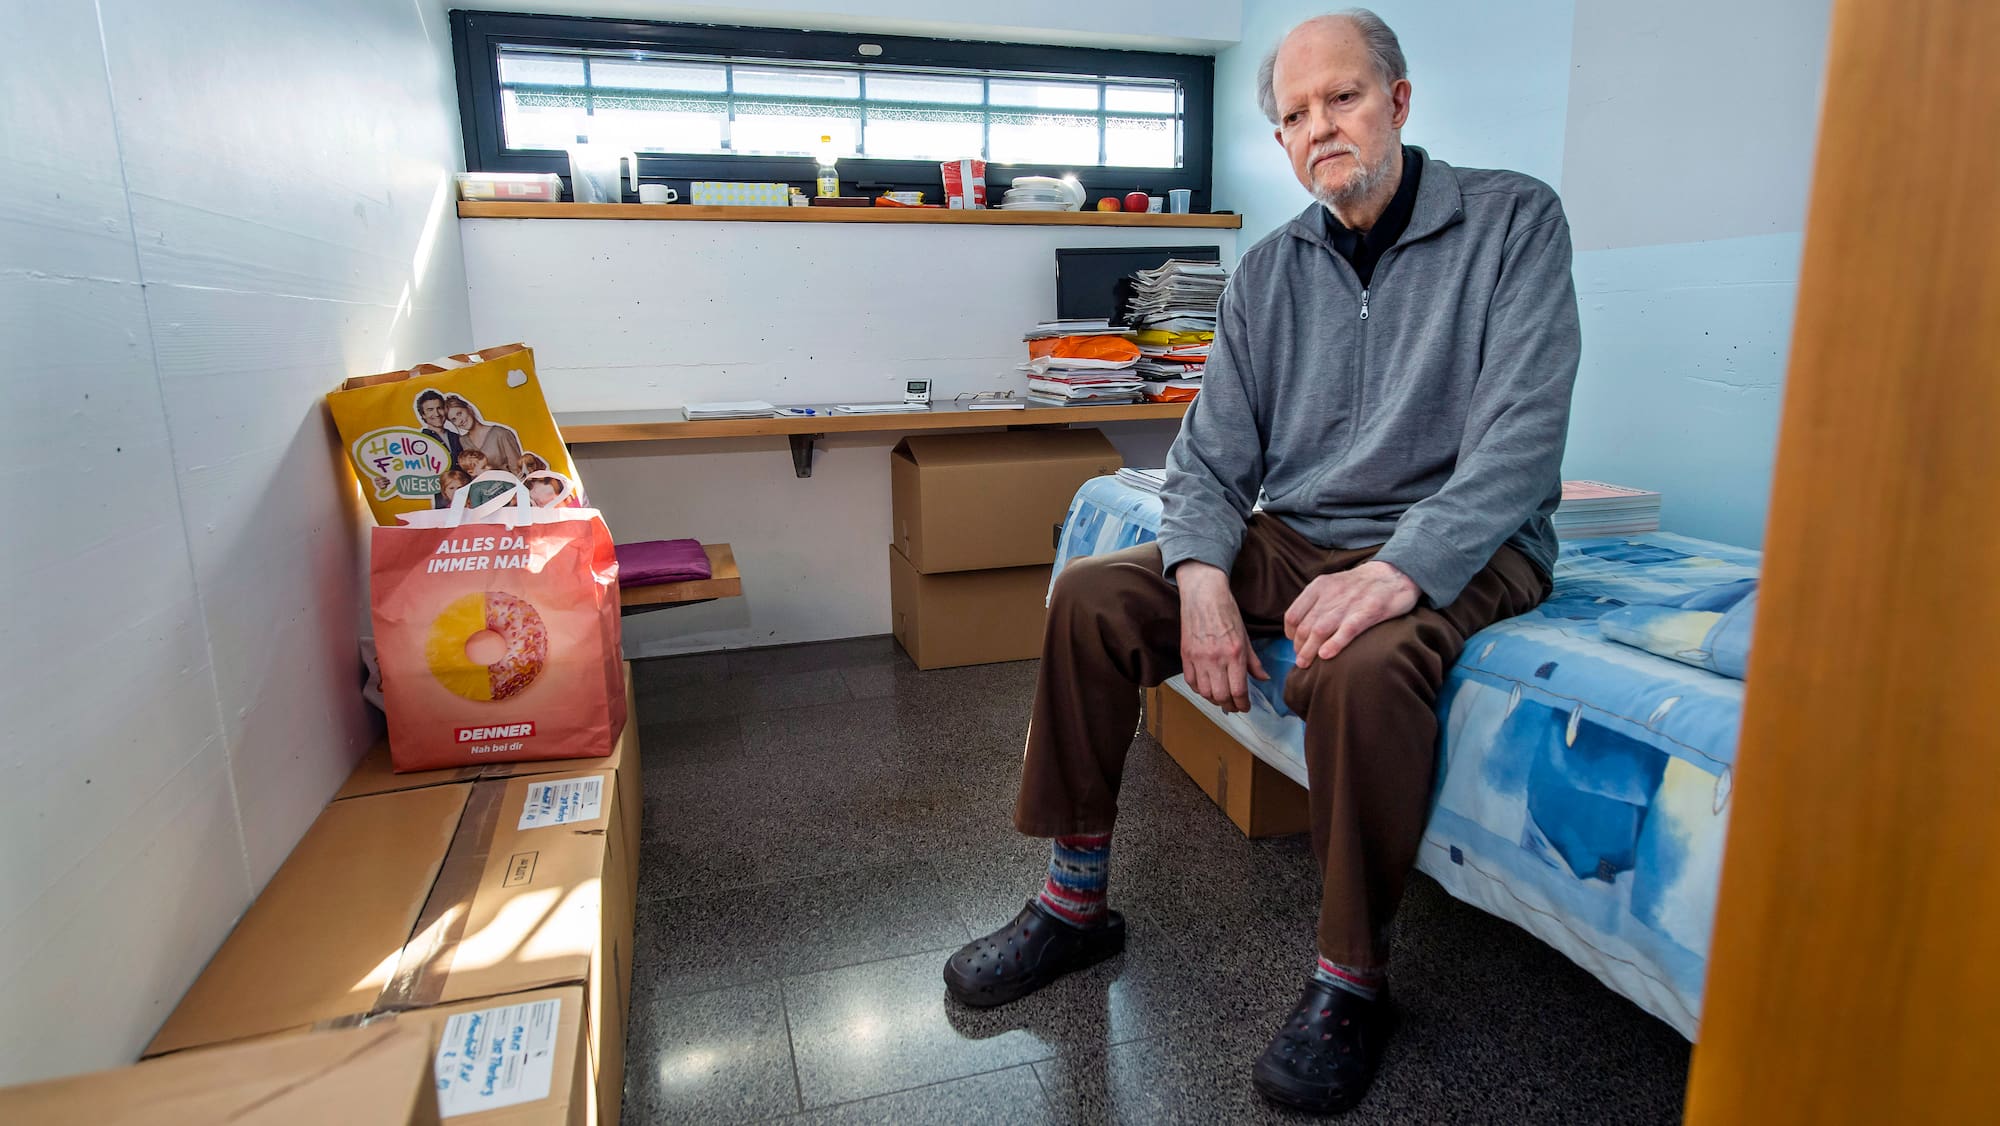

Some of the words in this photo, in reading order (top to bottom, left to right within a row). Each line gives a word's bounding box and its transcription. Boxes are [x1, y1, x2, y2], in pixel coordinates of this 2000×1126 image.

[368, 437, 428, 456] Hello
[373, 454, 441, 474] Family
[400, 477, 441, 492] WEEKS
[436, 537, 495, 554] ALLES
[499, 536, 530, 550] DA.
[427, 555, 490, 574] IMMER
[459, 723, 532, 742] DENNER
[471, 745, 490, 754] Nah
[492, 743, 508, 753] bei
[509, 741, 523, 751] dir
